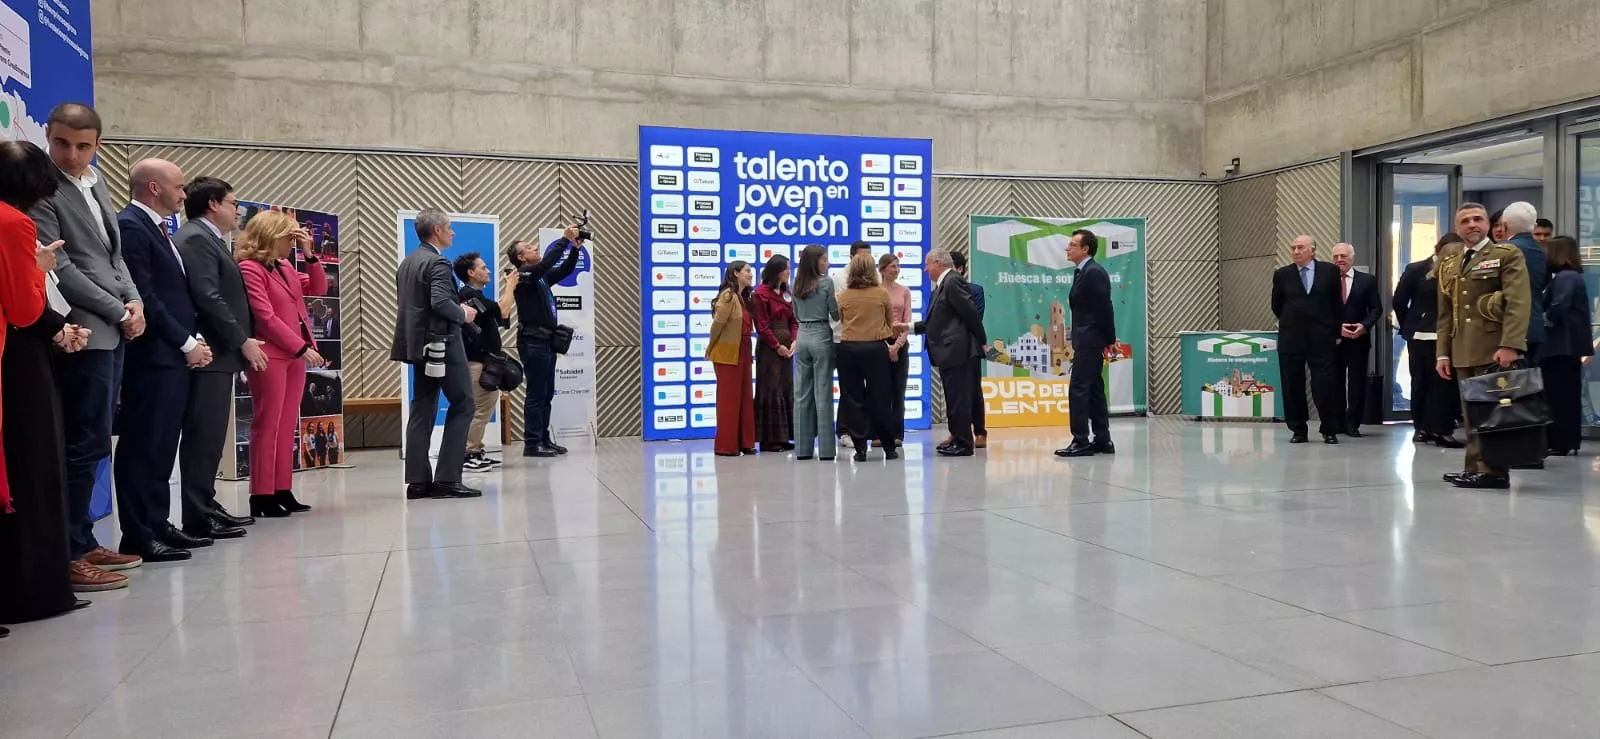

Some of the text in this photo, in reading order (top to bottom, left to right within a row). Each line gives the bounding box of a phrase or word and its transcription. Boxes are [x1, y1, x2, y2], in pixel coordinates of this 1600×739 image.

[734, 150, 849, 183] talento
[735, 184, 849, 213] joven en
[735, 207, 849, 237] acción
[998, 272, 1040, 284] Huesca
[1042, 273, 1053, 284] te
[981, 380, 1036, 399] OUR
[985, 400, 1070, 414] LENTO
